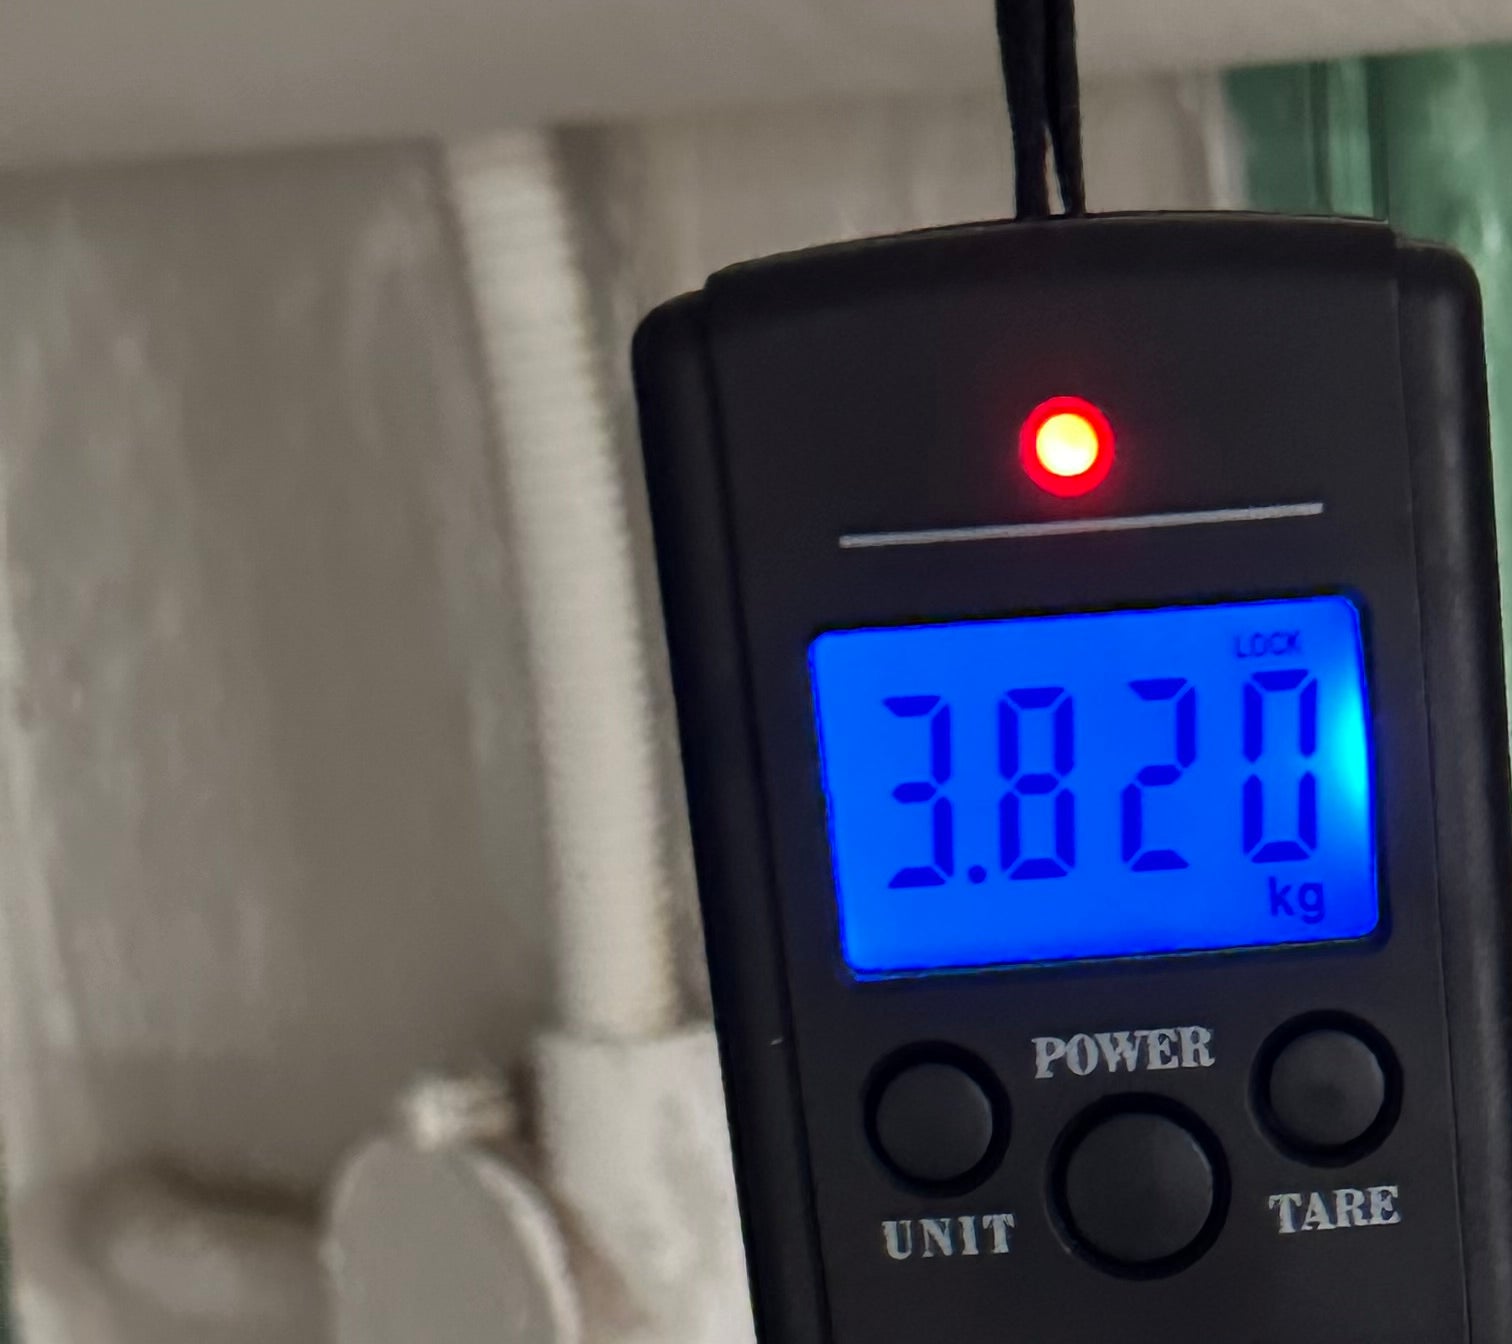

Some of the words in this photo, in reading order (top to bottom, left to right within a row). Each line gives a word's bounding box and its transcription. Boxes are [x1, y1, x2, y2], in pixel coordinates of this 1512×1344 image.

[882, 669, 1317, 889] 3.820
[1268, 876, 1326, 924] kg
[1032, 1025, 1216, 1079] POWER
[1268, 1185, 1402, 1235] TARE
[881, 1213, 1016, 1261] UNIT
